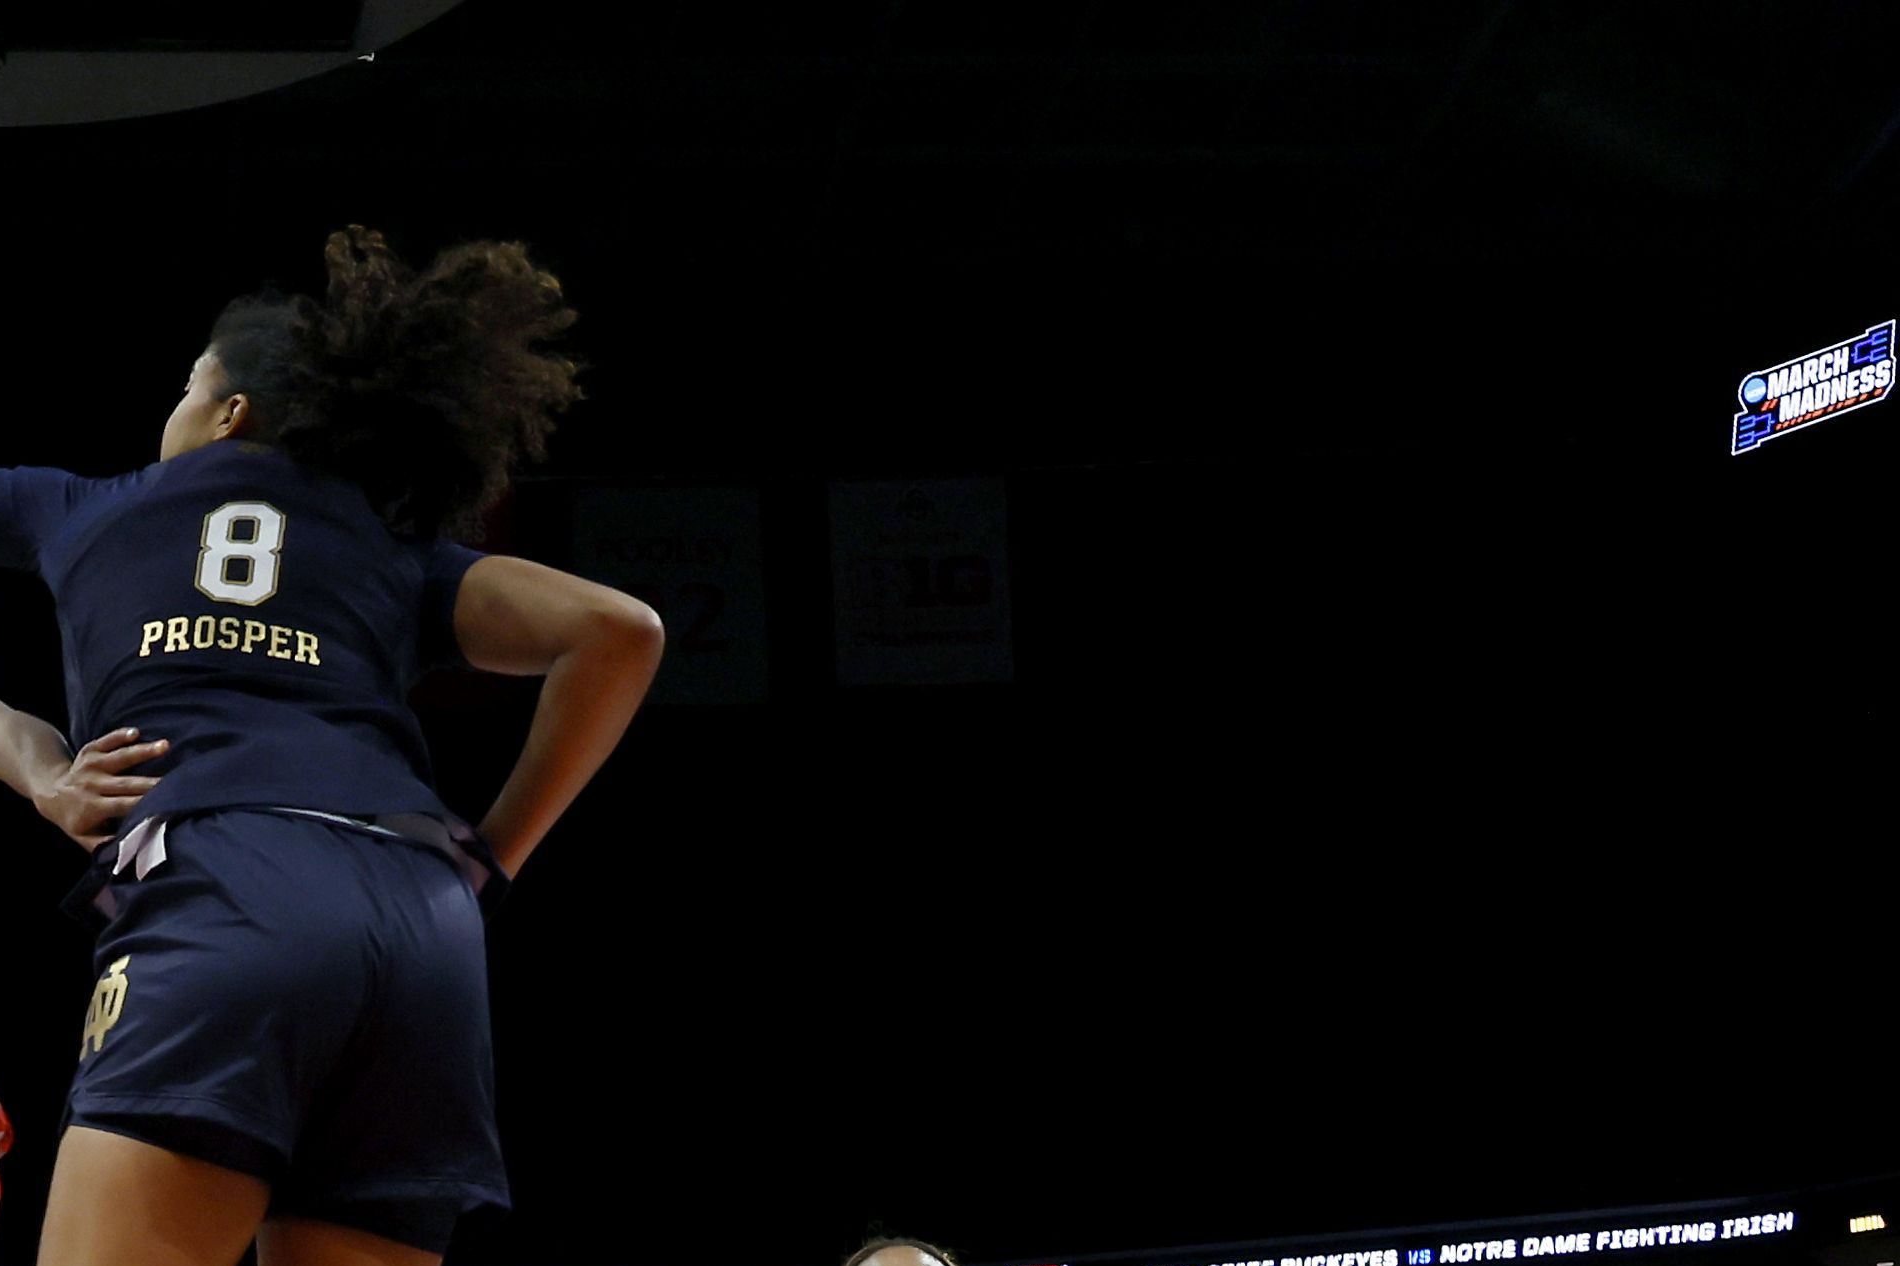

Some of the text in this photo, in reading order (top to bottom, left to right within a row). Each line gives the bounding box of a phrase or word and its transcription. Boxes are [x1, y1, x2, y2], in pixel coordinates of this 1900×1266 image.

[1767, 346, 1849, 400] MARCH
[1778, 360, 1892, 423] MADNESS
[194, 501, 287, 606] 8
[139, 615, 321, 666] PROSPER
[1407, 1249, 1431, 1265] VS
[1440, 1239, 1516, 1264] NOTRE
[1522, 1233, 1590, 1256] DAME
[1596, 1222, 1716, 1250] FIGHTING
[1721, 1212, 1794, 1239] IRISH
